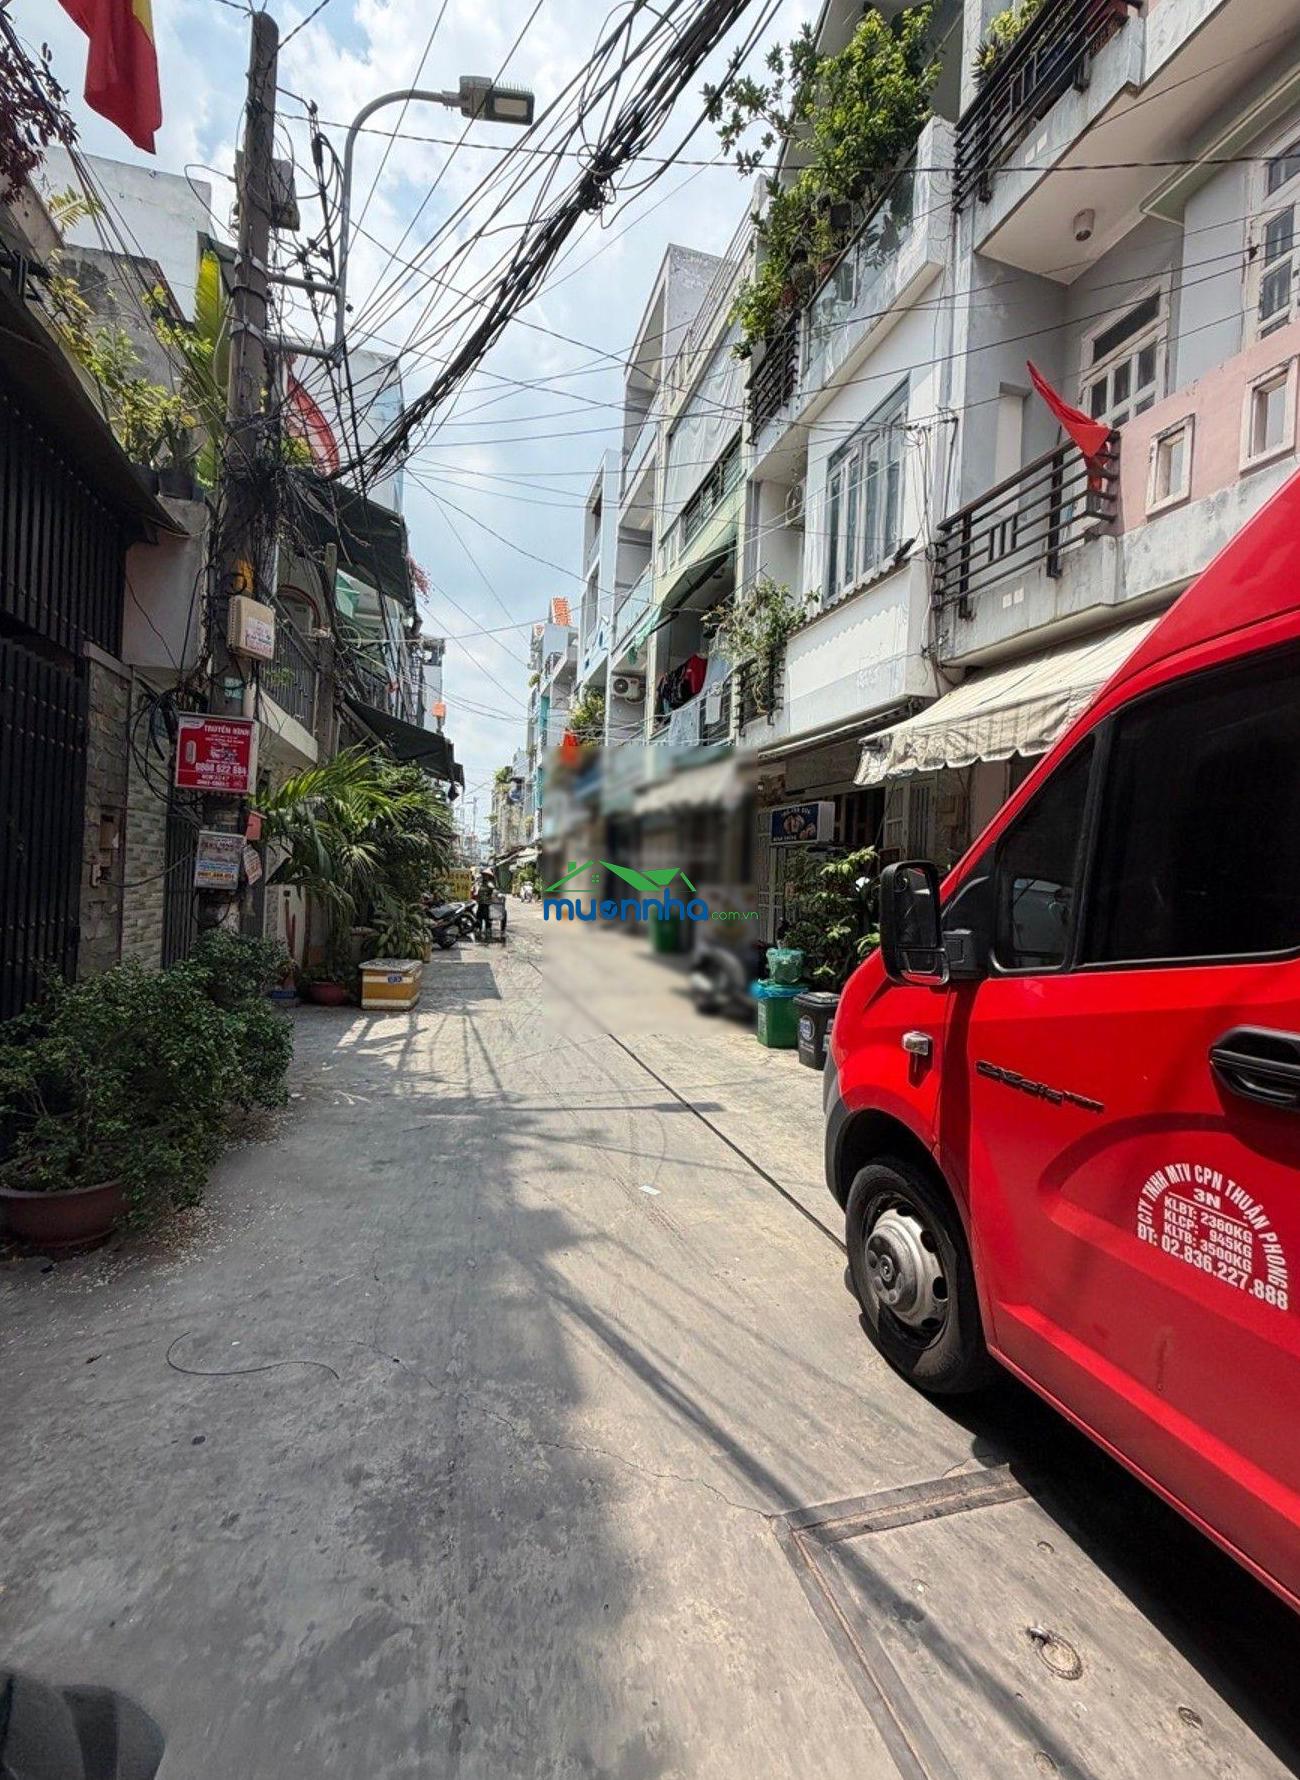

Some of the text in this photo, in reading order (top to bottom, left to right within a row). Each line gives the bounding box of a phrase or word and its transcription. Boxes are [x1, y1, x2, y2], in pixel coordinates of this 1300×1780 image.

[1141, 1170, 1169, 1202] TNHH
[1164, 1163, 1192, 1184] MTV
[1194, 1164, 1223, 1191] CPN
[1137, 1197, 1153, 1225] CTY
[1164, 1195, 1198, 1221] KLBT:
[1193, 1188, 1222, 1210] 3N
[1164, 1208, 1253, 1260] KLCP: 945KG
[1164, 1221, 1253, 1275] KLTB: 3500KG
[1161, 1235, 1289, 1312] 02.836.227.888
[1257, 1231, 1289, 1289] PHONG
